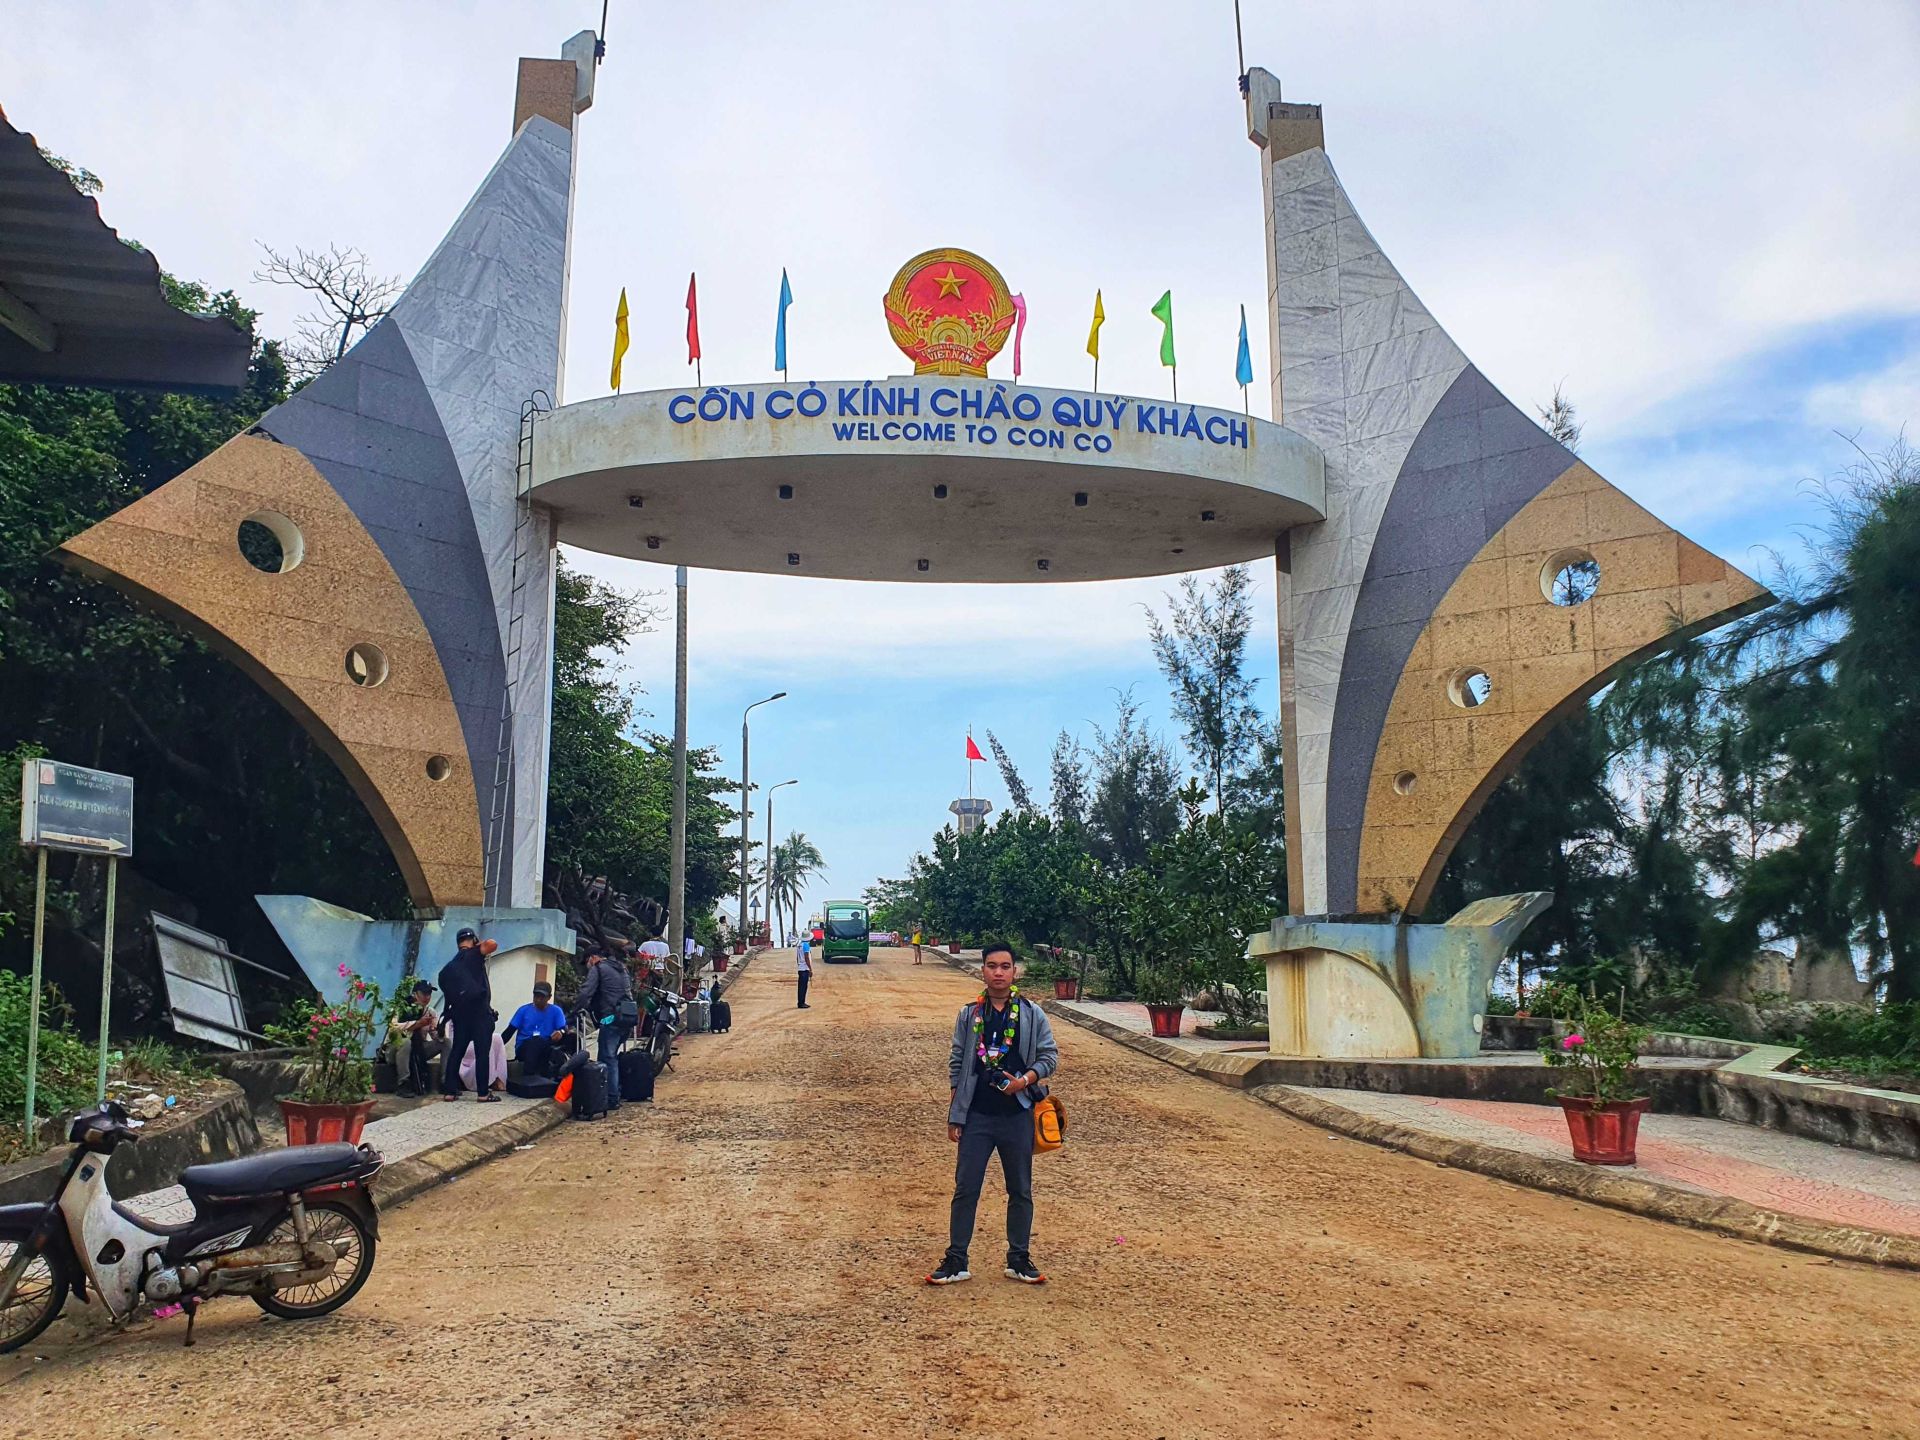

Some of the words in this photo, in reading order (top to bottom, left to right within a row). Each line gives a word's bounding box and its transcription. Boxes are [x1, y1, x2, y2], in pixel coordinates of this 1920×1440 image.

[668, 386, 755, 424] CỒN
[764, 380, 828, 420] CỎ
[837, 379, 920, 417] KÍNH
[929, 383, 1042, 422] CHÀO
[1051, 395, 1128, 431] QUÝ
[1136, 403, 1248, 449] KHÁCH
[832, 422, 956, 442] WELCOME
[965, 424, 998, 445] TO
[1007, 426, 1065, 449] CON
[1073, 432, 1113, 454] CO
